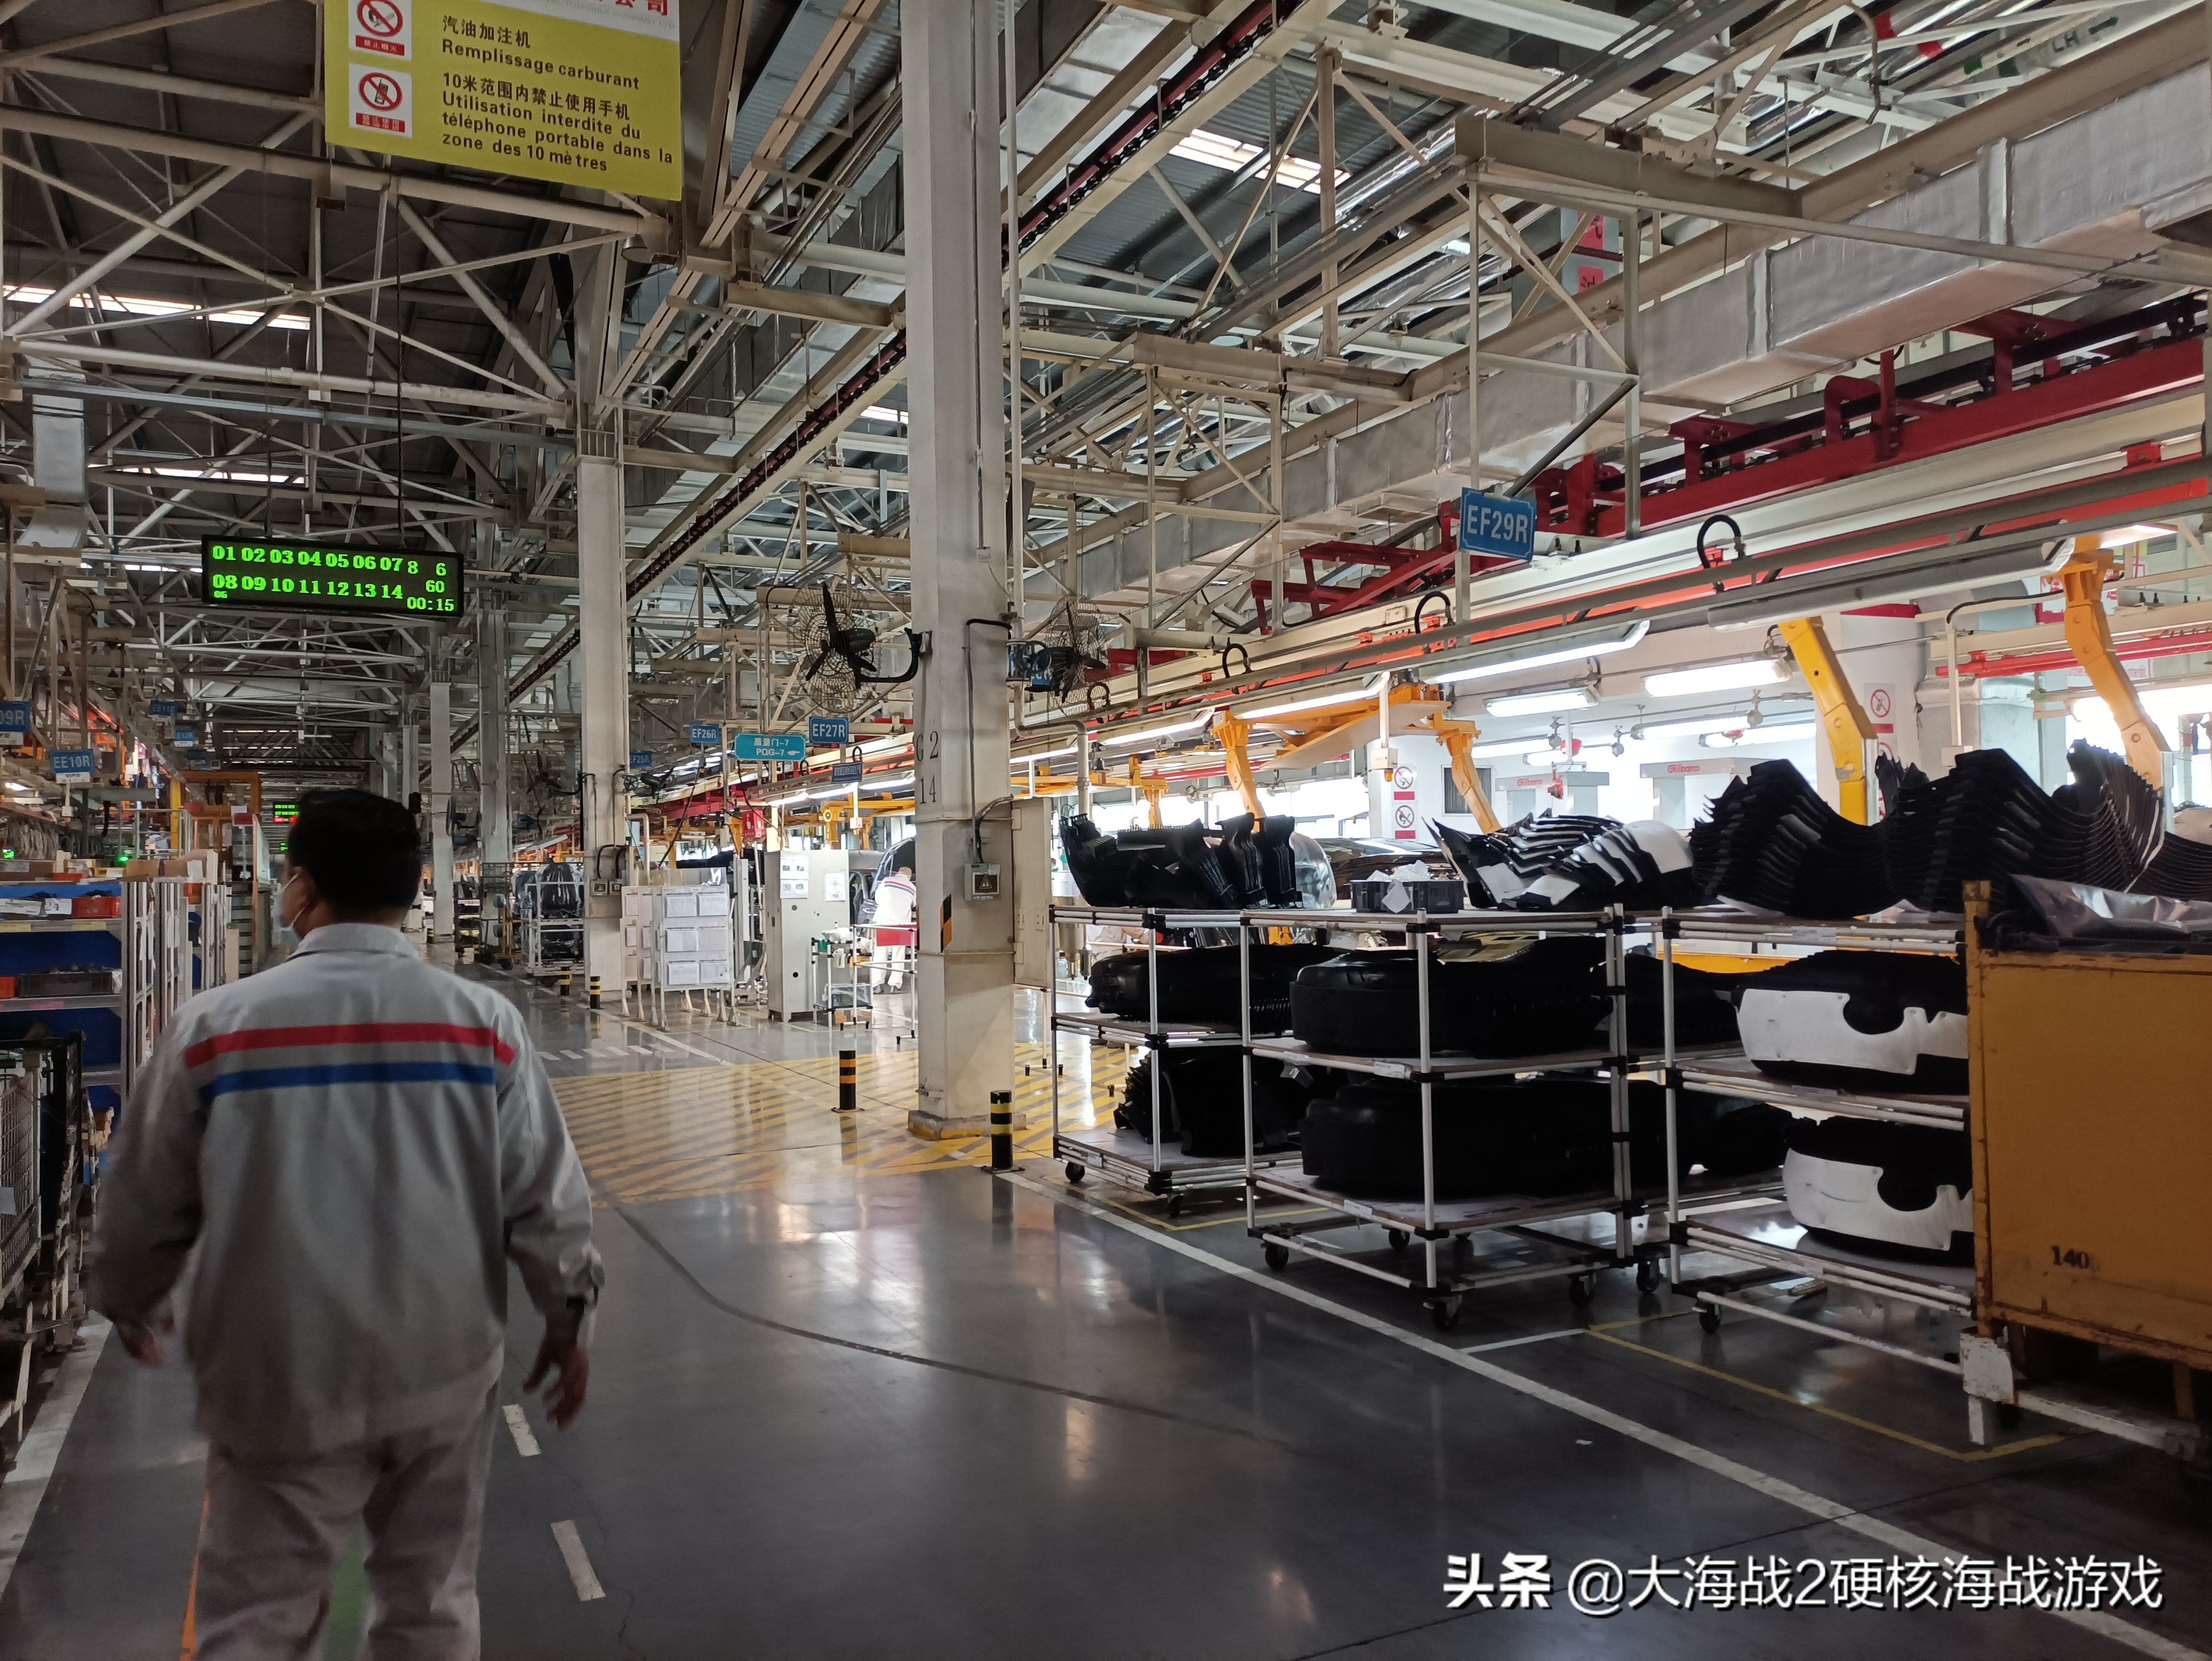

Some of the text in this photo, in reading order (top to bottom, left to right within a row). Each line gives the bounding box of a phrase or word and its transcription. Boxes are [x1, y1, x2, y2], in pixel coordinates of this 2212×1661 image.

[443, 15, 531, 48] 汽油加注机
[442, 38, 640, 90] Remplissage carburant
[443, 72, 630, 121] 10米范围内禁止使用手机
[442, 91, 641, 140] Utilisation interdite du
[442, 112, 673, 164] téléphone portable dans la
[442, 133, 484, 150] zone
[492, 139, 521, 156] des
[527, 145, 544, 160] 10
[1467, 505, 1528, 544] EF29R
[212, 545, 447, 576] 01 02 03 04 05 06 07 8 6
[212, 574, 445, 599] 08 09 10 11 12 13 14 60
[407, 597, 454, 612] 00:15
[692, 729, 717, 739] EF26R
[754, 738, 789, 747] 质量门-7
[812, 723, 845, 738] EF27R
[53, 755, 90, 769] EE10R
[756, 748, 785, 756] PQG-7
[919, 775, 937, 804] 14
[2051, 1246, 2090, 1269] 140
